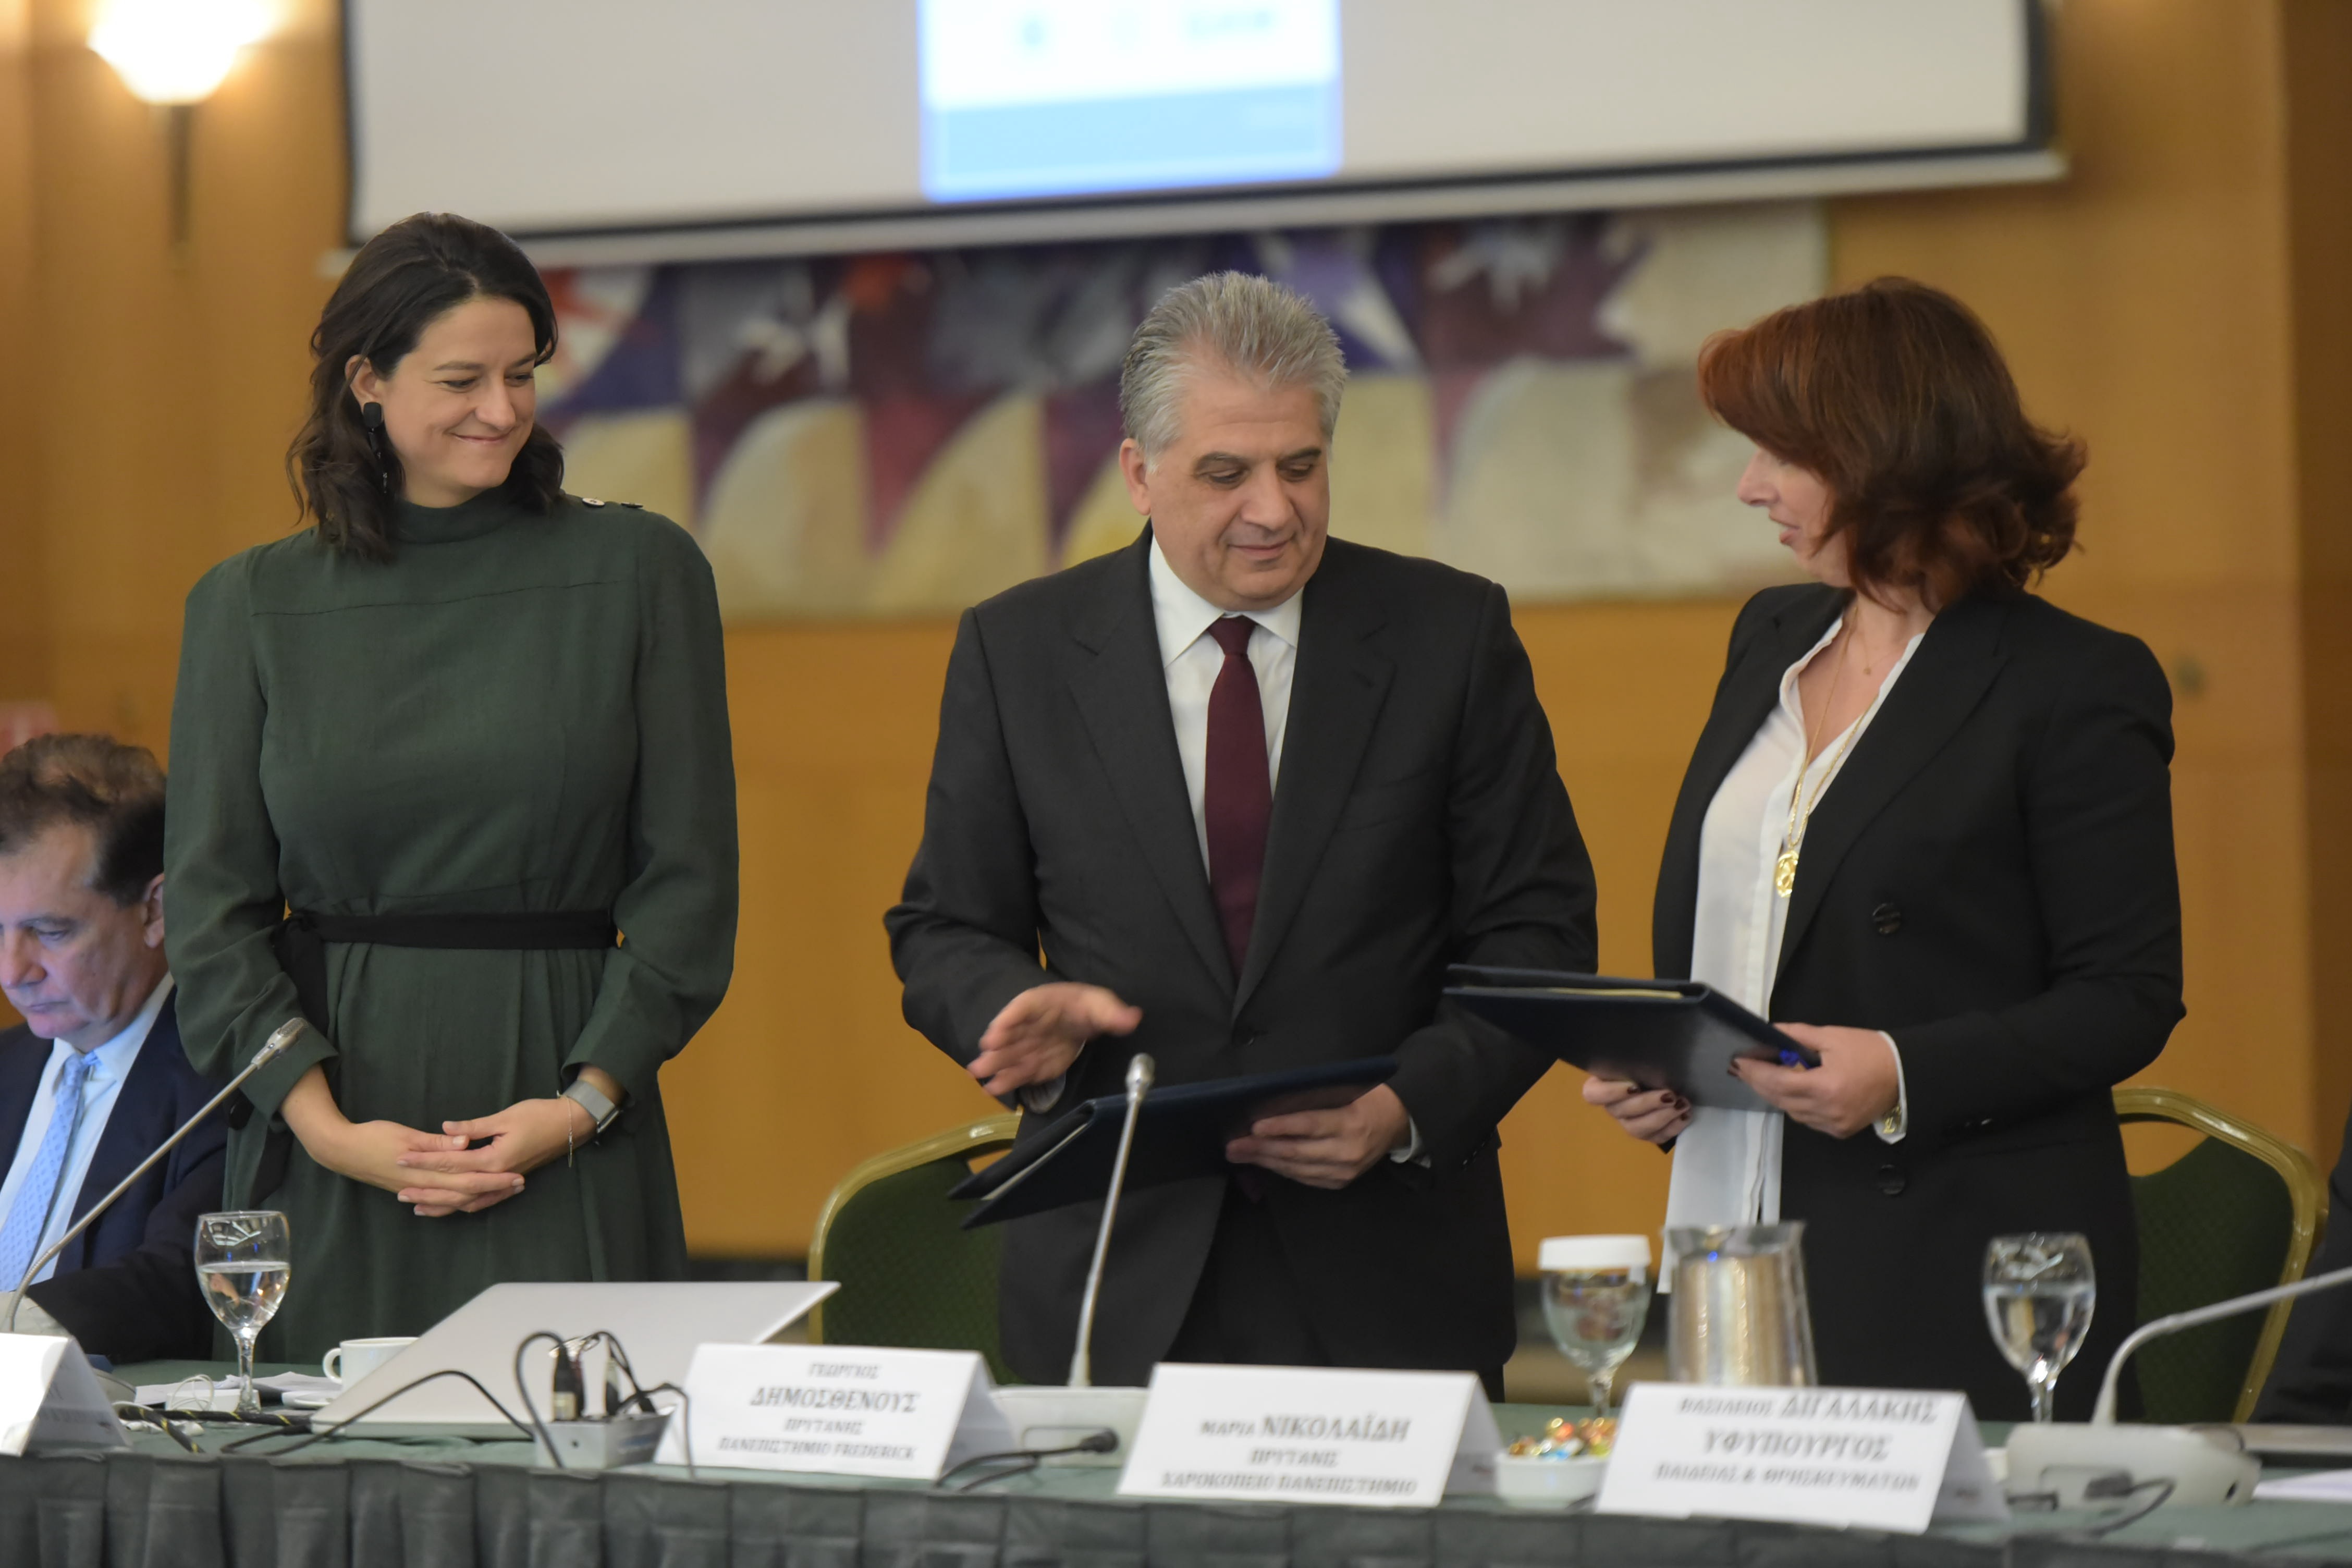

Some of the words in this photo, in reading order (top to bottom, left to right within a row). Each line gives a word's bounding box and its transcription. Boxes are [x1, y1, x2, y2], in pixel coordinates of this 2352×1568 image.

[750, 1387, 920, 1412] ΔΗΜΟΣΘΕΝΟΥΣ
[1780, 1393, 1940, 1424] ΔΙΓΑΛΑΚΗΣ
[1199, 1420, 1256, 1436] ΜΑΡΙΑ
[1261, 1412, 1412, 1443] ΝΙΚΟΛΑΪΔΗ
[1705, 1428, 1893, 1461] ΥΦΥΠΟΥΡΓΟΣ
